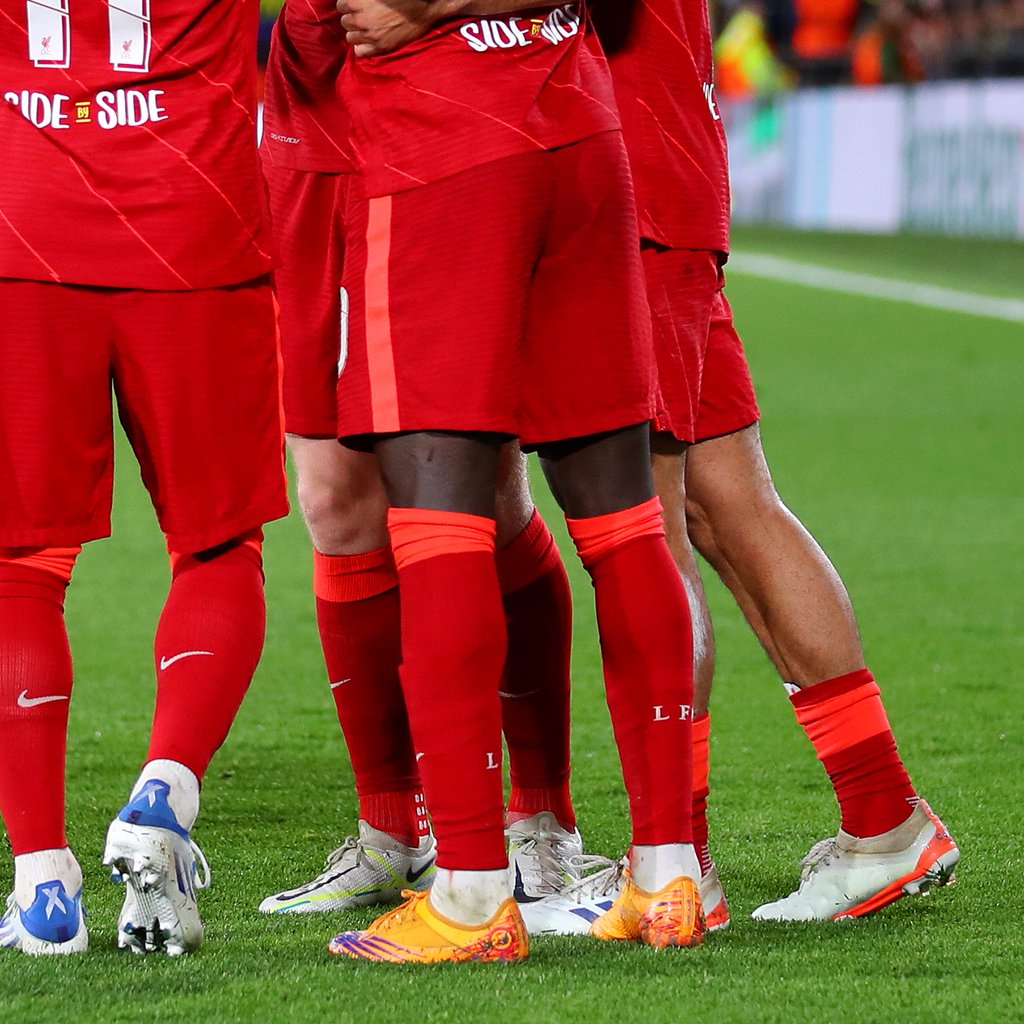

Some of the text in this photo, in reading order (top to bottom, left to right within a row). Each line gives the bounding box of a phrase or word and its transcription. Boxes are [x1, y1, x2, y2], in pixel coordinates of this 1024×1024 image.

[77, 106, 89, 119] BY
[95, 88, 169, 130] SIDE
[486, 752, 499, 770] L
